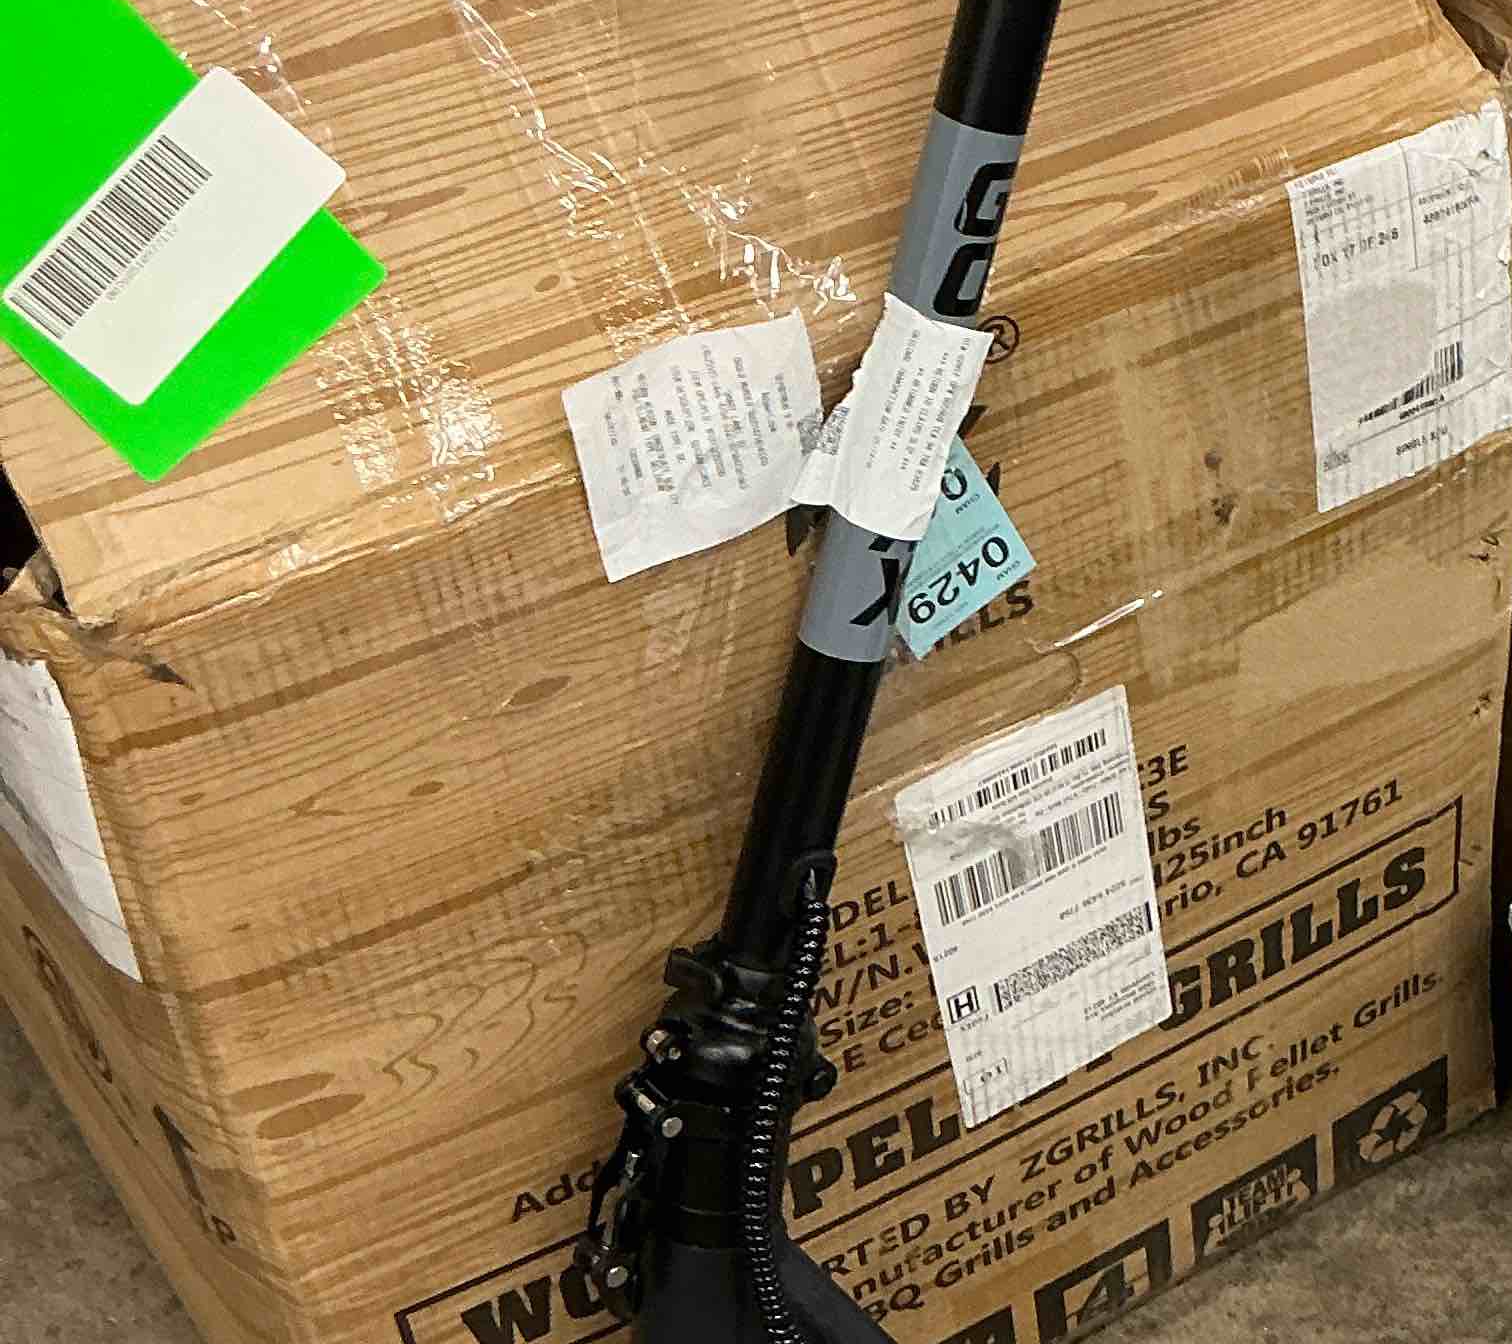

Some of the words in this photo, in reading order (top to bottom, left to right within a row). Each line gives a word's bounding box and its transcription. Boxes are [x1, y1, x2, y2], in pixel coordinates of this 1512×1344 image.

[906, 535, 1010, 624] 0429
[1236, 840, 1288, 879] CA
[1297, 778, 1403, 847] 91761
[819, 990, 914, 1049] Size:
[1162, 844, 1428, 1032] GRILLS
[852, 1175, 1075, 1301] nufacturer
[1074, 1149, 1117, 1186] of
[1122, 1082, 1235, 1156] Wood
[1352, 971, 1445, 1031] Grills.
[934, 1225, 1036, 1290] Grills
[1046, 1177, 1116, 1231] and
[1129, 1060, 1342, 1184] Accessories.
[943, 1173, 997, 1223] BY
[1197, 1035, 1279, 1090] INC.
